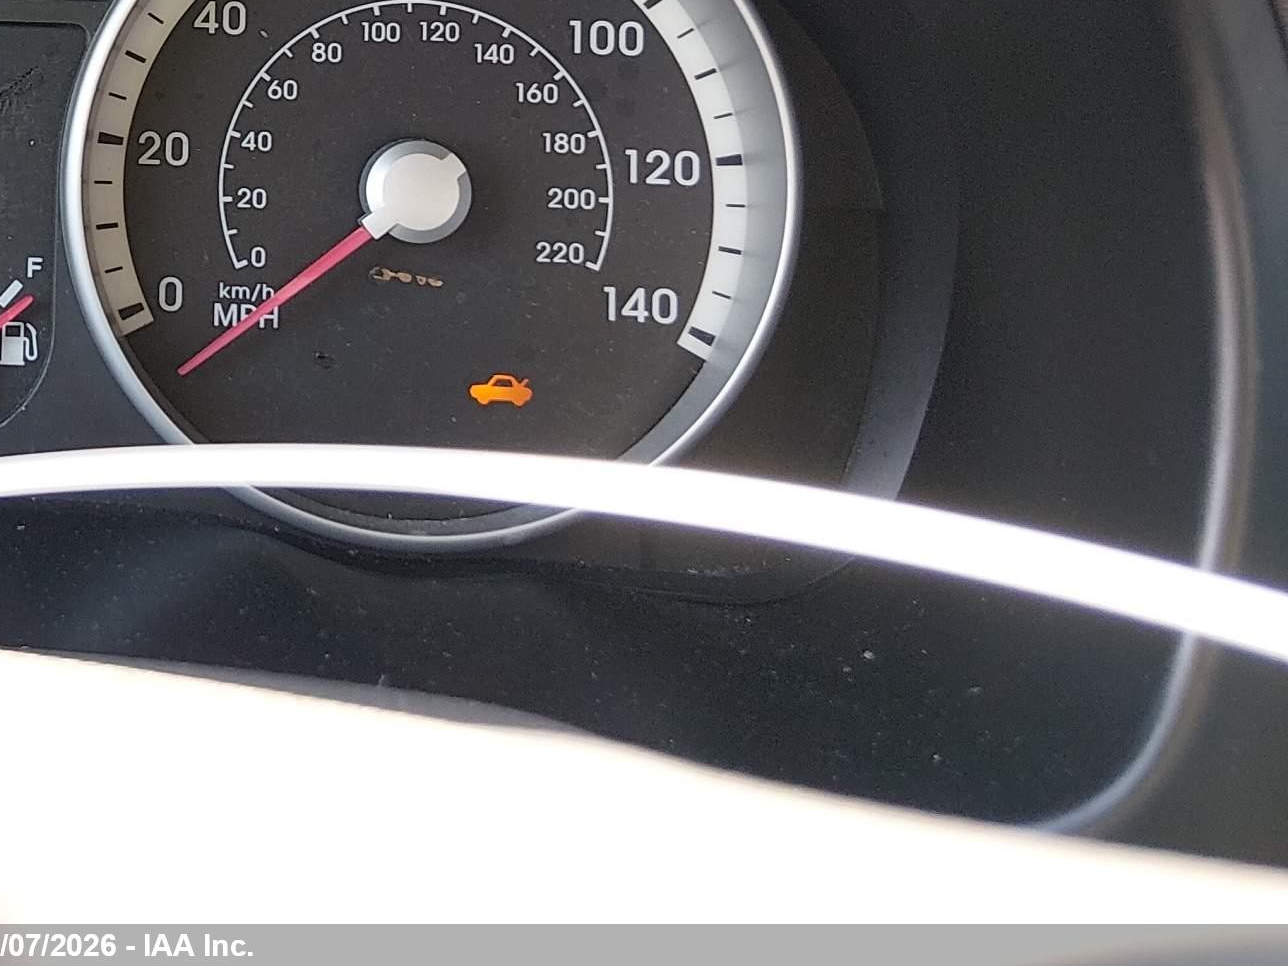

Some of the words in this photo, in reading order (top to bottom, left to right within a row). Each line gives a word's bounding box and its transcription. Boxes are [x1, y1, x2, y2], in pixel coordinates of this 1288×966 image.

[193, 0, 247, 36] 40
[361, 21, 401, 44] 100
[419, 21, 461, 44] 120
[569, 20, 645, 57] 100
[311, 41, 343, 64] 80
[474, 42, 515, 66] 140
[266, 79, 298, 101] 60
[515, 81, 559, 106] 160
[137, 131, 190, 167] 20
[241, 130, 273, 153] 40
[541, 132, 586, 155] 180
[624, 149, 701, 187] 120
[236, 188, 268, 210] 20
[546, 187, 596, 211] 200
[249, 247, 267, 269] 0
[535, 241, 586, 265] 220
[27, 257, 43, 278] F
[157, 275, 183, 312] 0
[218, 282, 276, 302] km/h
[603, 286, 679, 324] 140
